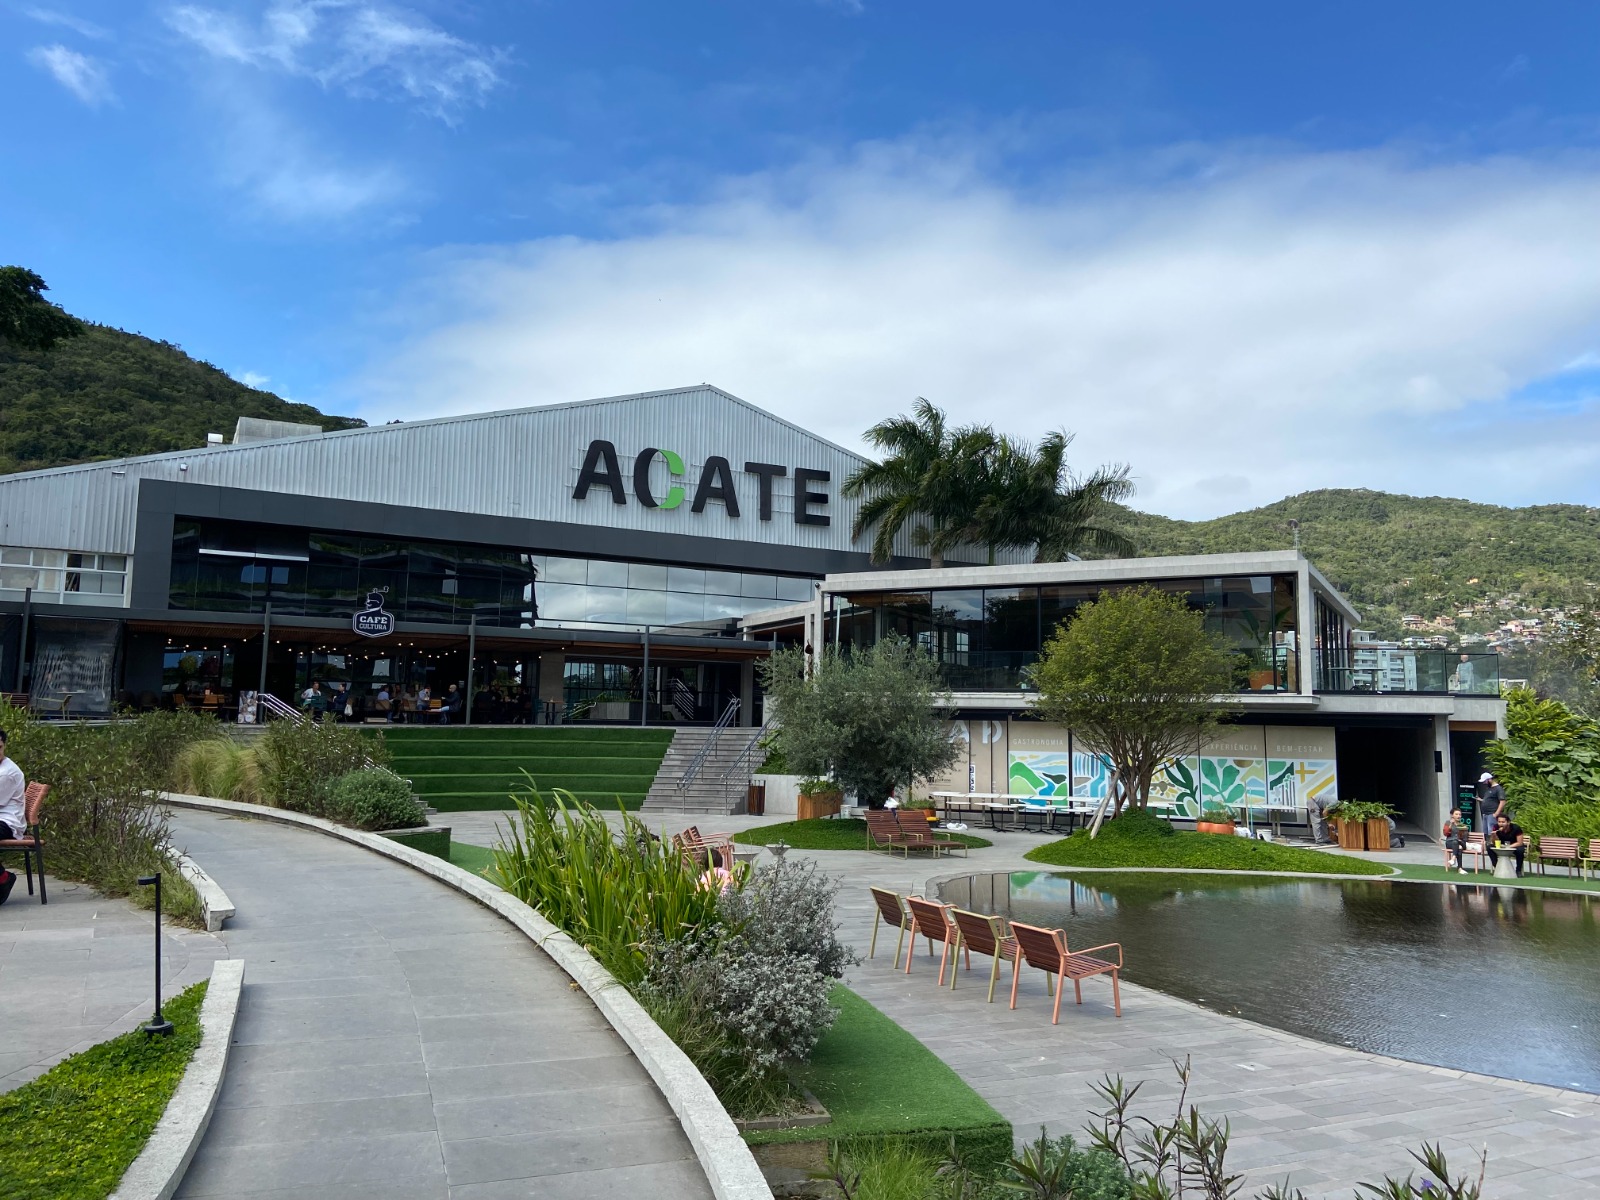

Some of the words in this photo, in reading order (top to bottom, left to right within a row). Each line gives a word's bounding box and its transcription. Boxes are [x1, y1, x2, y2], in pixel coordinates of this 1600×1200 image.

[572, 440, 831, 527] ACATE
[1012, 738, 1064, 746] GASTRONOMIA
[1276, 745, 1324, 753] BEM-ESTAR
